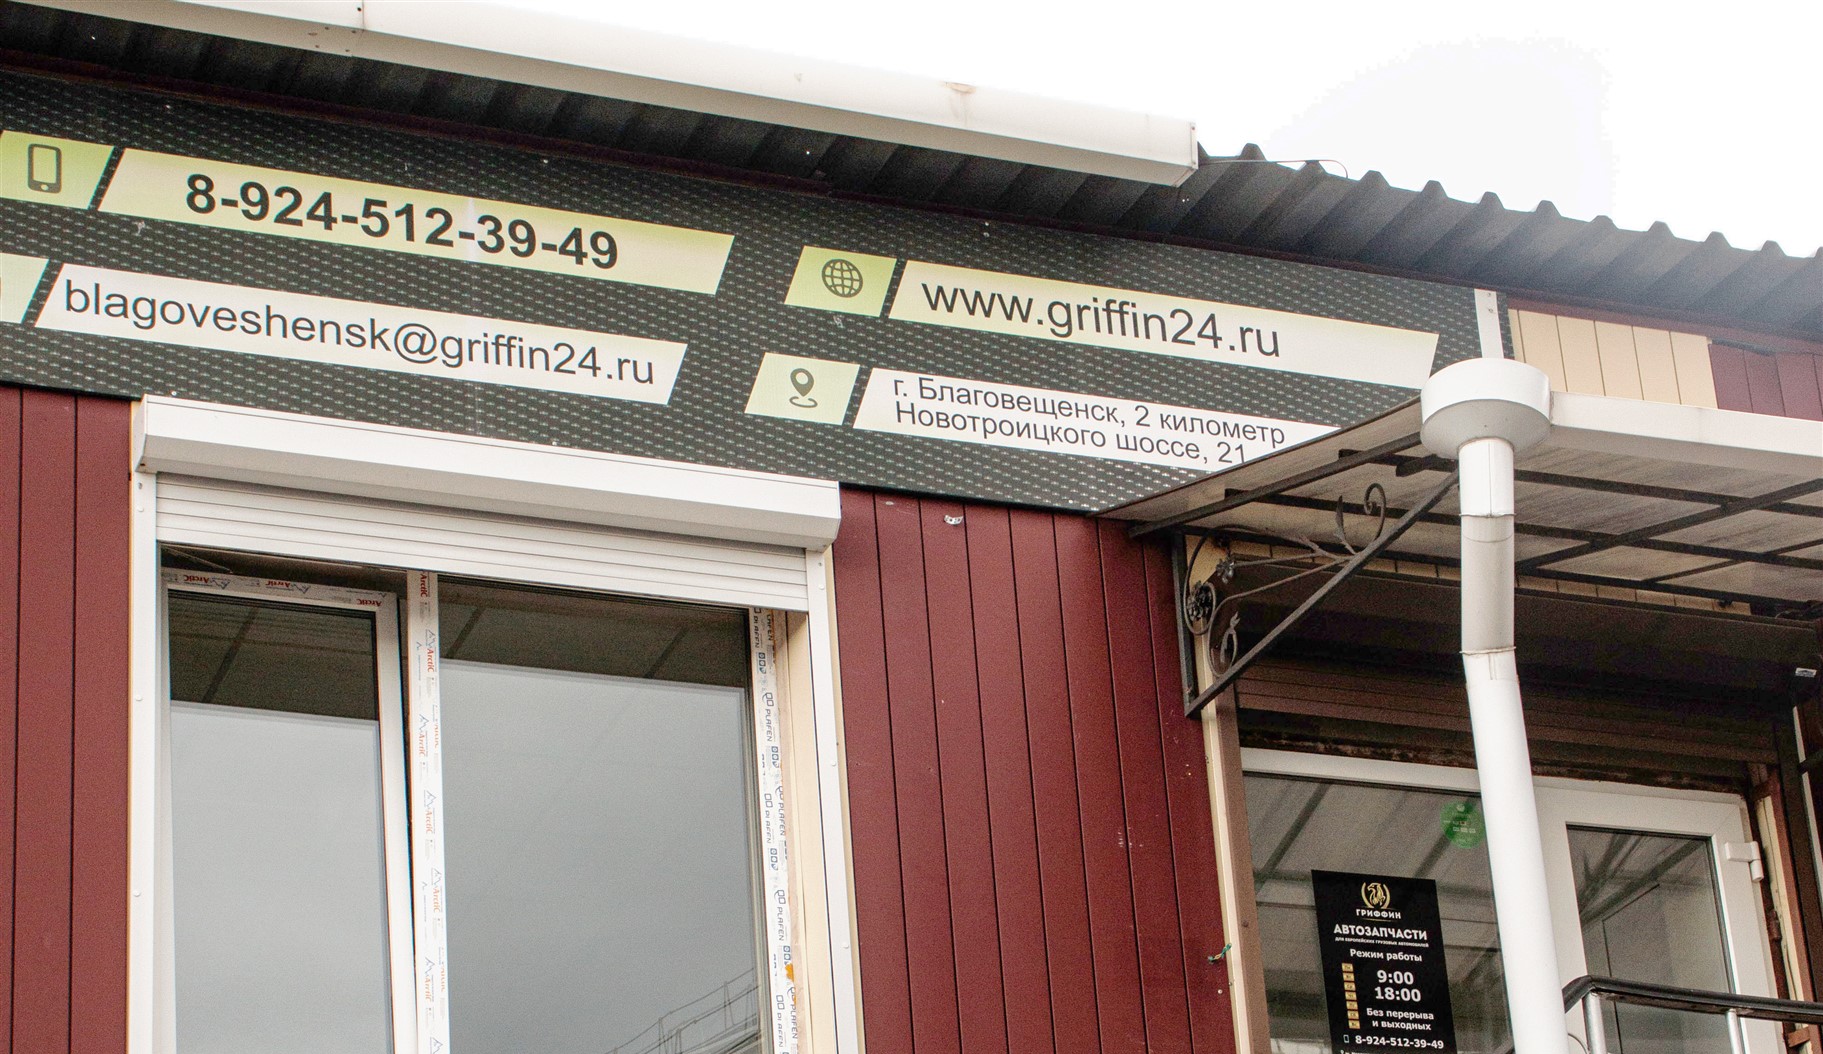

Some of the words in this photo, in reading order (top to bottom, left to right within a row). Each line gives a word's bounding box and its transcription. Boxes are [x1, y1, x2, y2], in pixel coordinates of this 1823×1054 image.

[185, 172, 618, 270] 8-924-512-39-49
[921, 281, 1280, 358] www.griffin24.ru
[65, 278, 654, 385] blagoveshensk@griffin24.ru
[893, 379, 908, 397] г.
[918, 376, 1125, 428] Благовещенск,
[1134, 404, 1151, 427] 2
[1159, 413, 1285, 449] километр
[895, 400, 1106, 448] Новотроицкого
[1115, 433, 1208, 464] шоссе,
[1355, 908, 1402, 920] ГРИФФИН
[1333, 923, 1428, 941] АВТОЗАПЧАСТИ
[1349, 948, 1384, 959] Режим
[1386, 951, 1423, 962] работы
[1376, 969, 1414, 985] 9:00
[1374, 986, 1422, 1002] 18:00
[1366, 1007, 1384, 1017] Без
[1386, 1009, 1435, 1020] перерыва
[1381, 1020, 1432, 1031] выходных
[1355, 1034, 1444, 1049] 8-924-512-39-49
